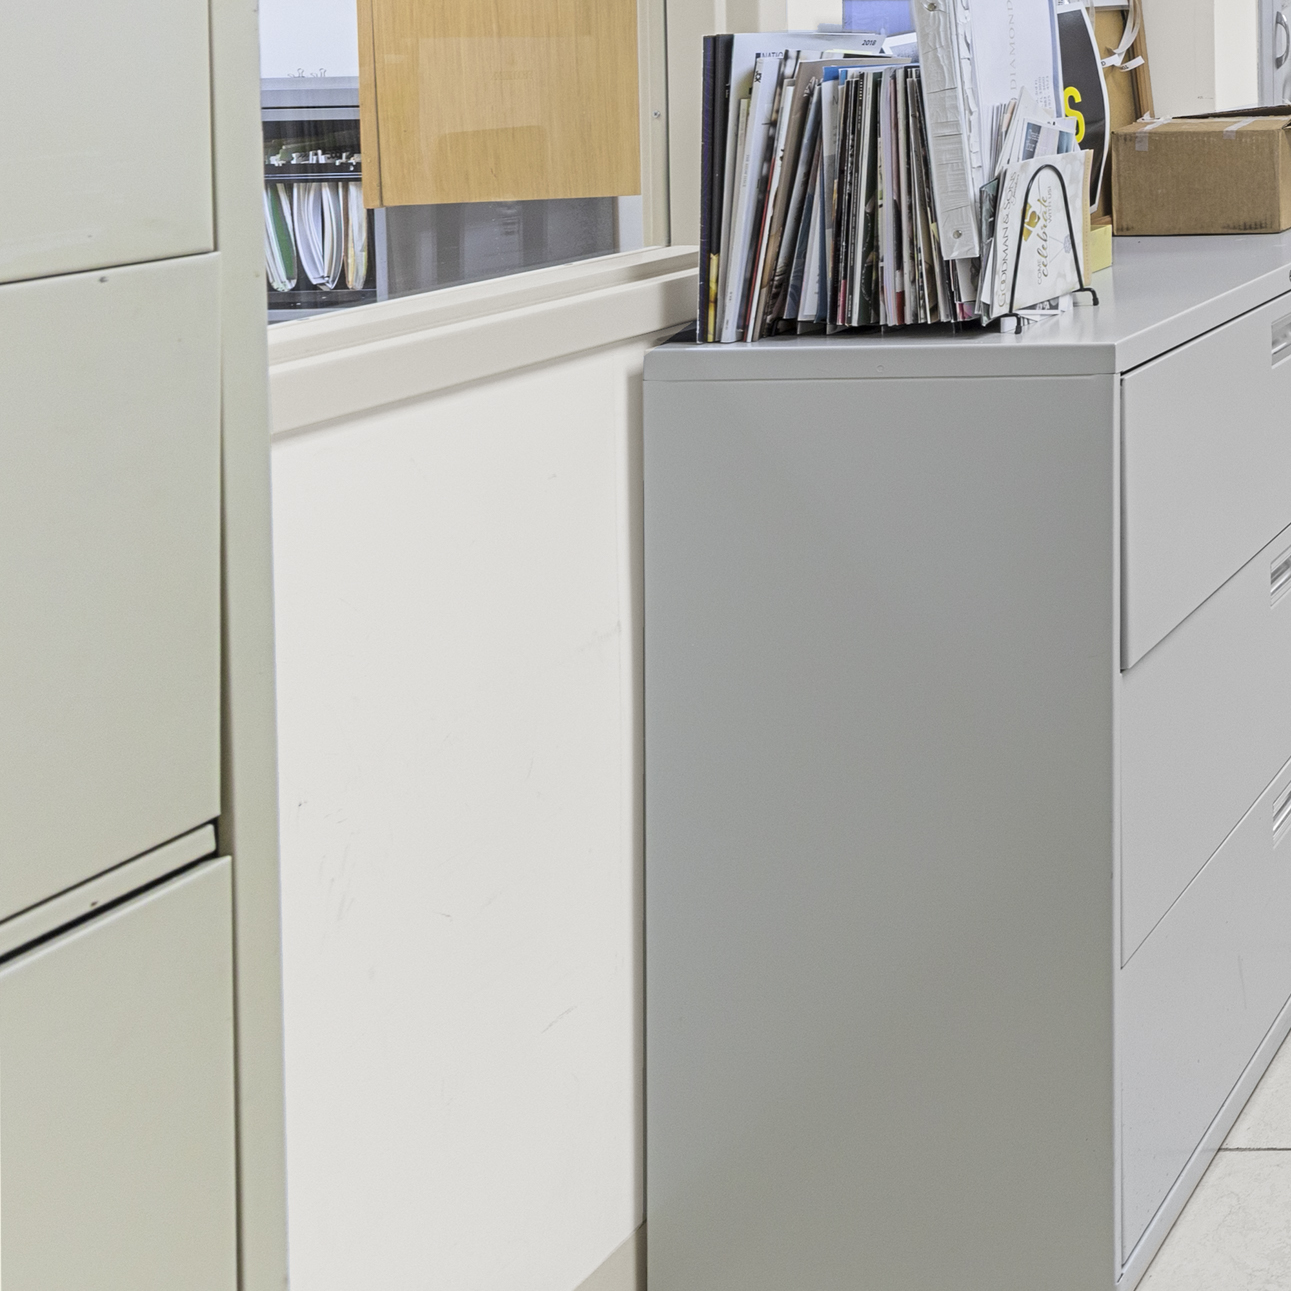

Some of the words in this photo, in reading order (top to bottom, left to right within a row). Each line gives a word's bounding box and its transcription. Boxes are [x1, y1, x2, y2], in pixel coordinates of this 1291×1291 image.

[861, 38, 878, 47] 2018
[1006, 0, 1017, 91] DIAMOND
[997, 226, 1009, 308] GOODMAN
[1003, 171, 1017, 210] SONS
[1036, 195, 1049, 278] celebrate
